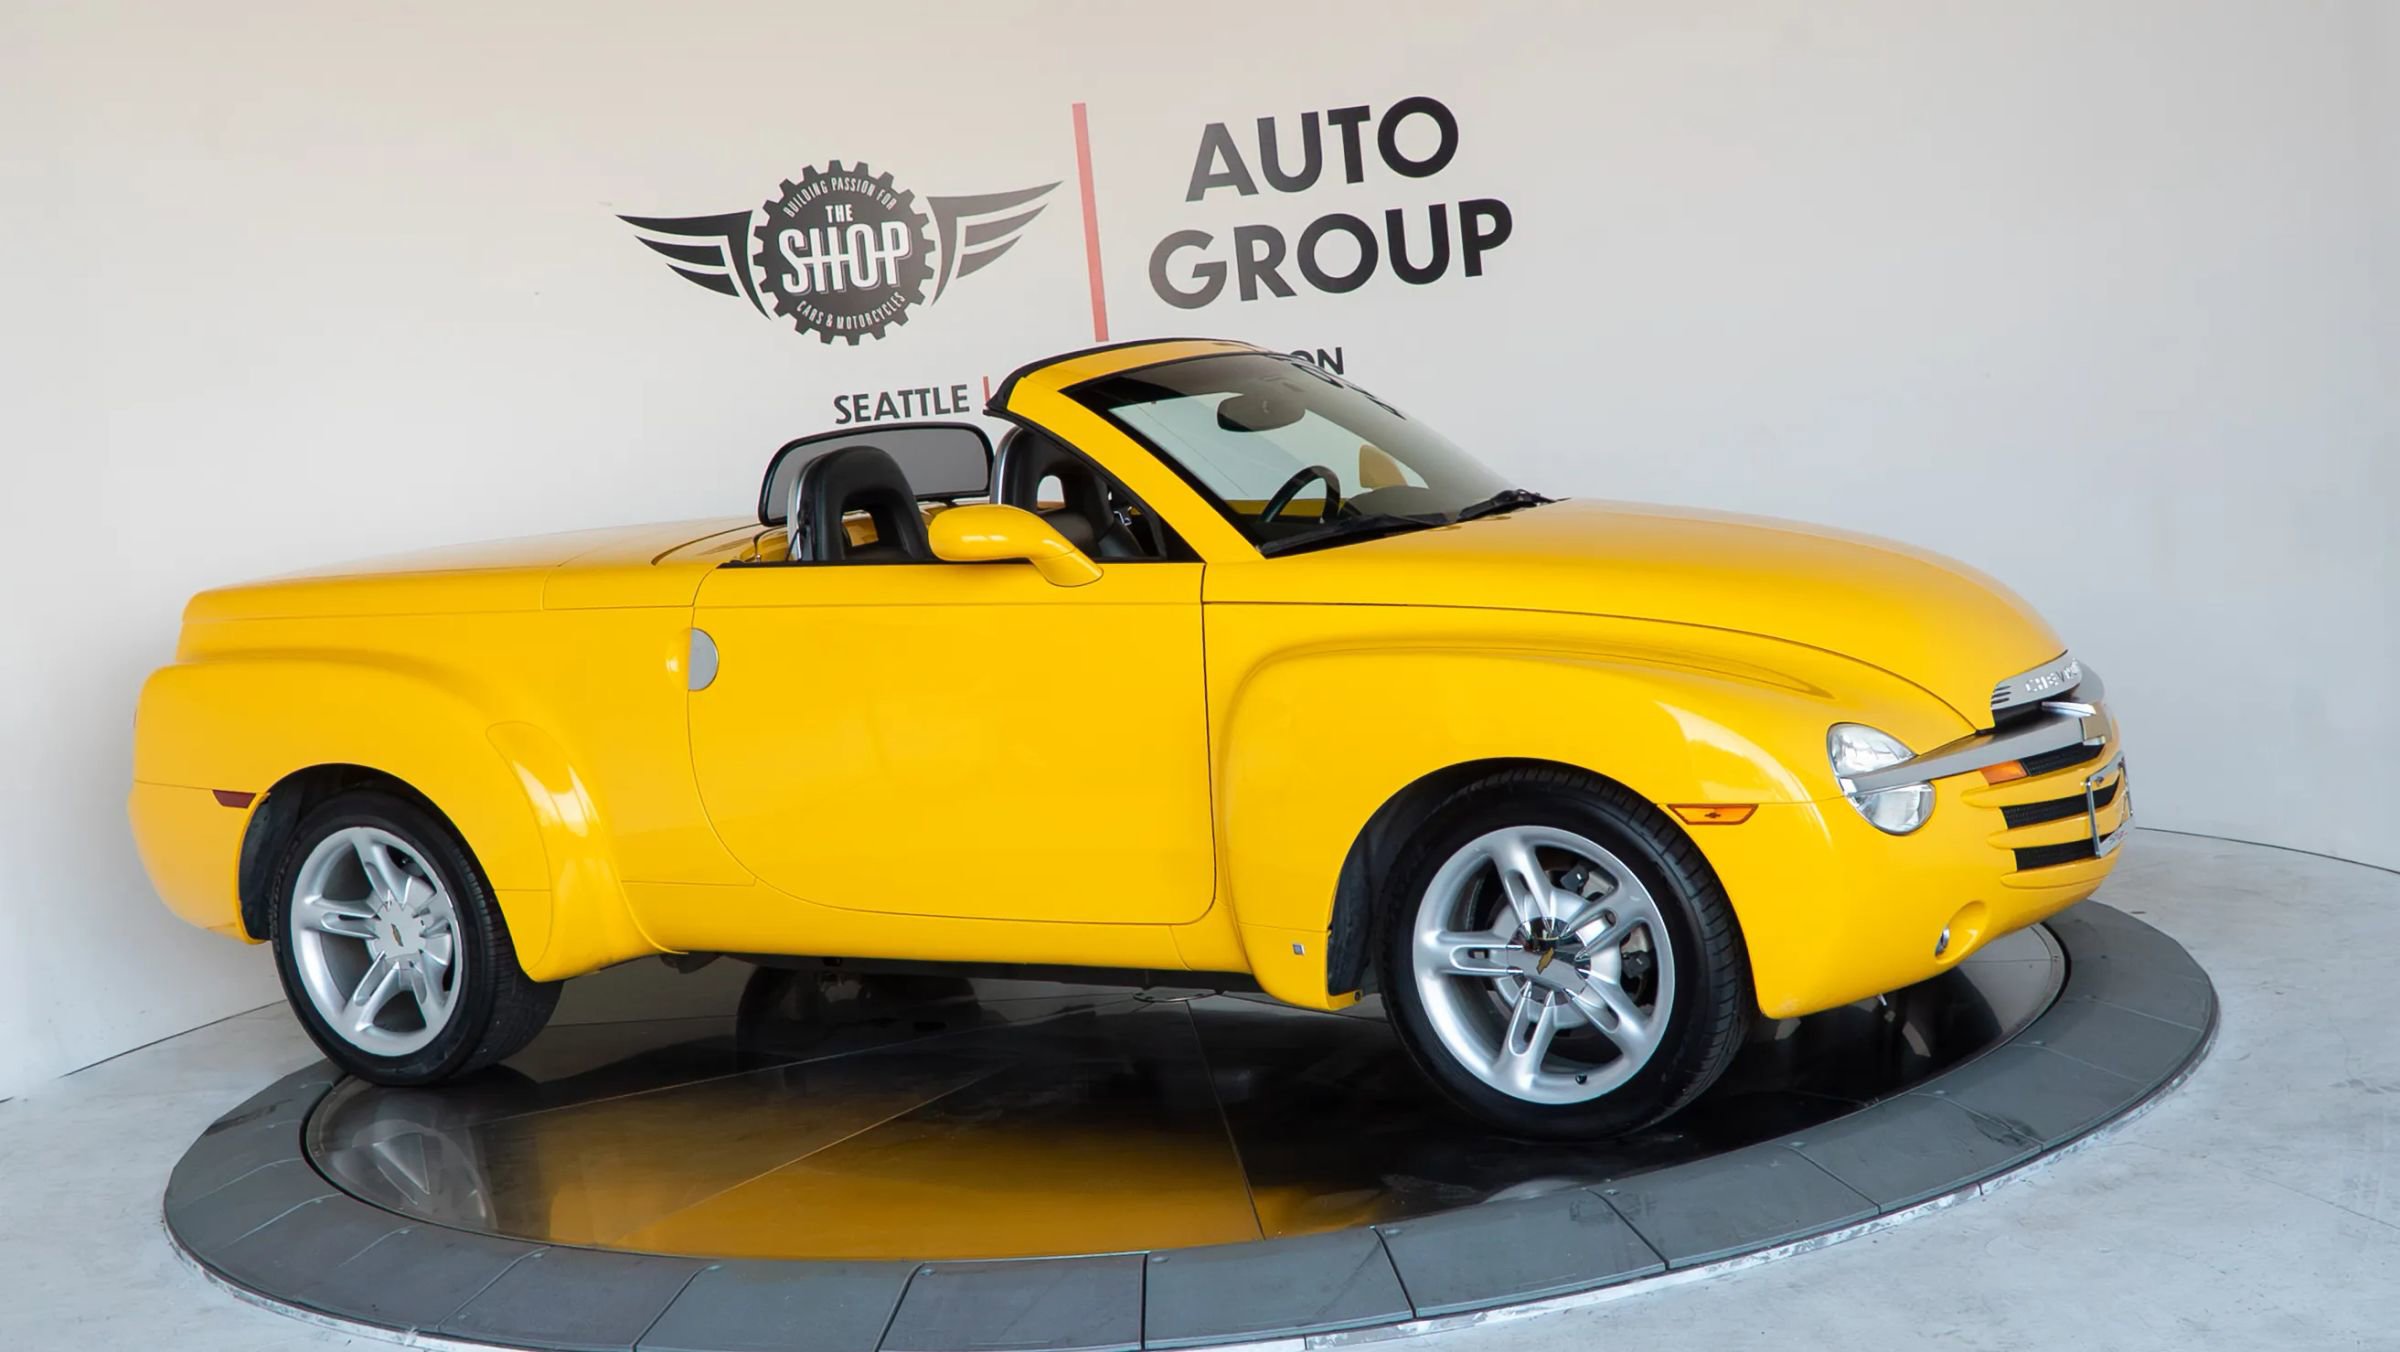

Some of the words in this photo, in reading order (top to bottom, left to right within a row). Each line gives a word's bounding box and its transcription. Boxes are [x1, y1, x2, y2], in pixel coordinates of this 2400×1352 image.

[1186, 96, 1459, 202] AUTO
[783, 180, 828, 218] BUILDING
[831, 177, 876, 197] PASSION
[876, 189, 897, 210] FOR
[825, 204, 853, 223] THE
[778, 221, 912, 296] SHOP
[1149, 198, 1513, 310] GROUP
[797, 301, 825, 325] CARS
[825, 314, 834, 327] &
[836, 291, 906, 330] MOTORCYCLES
[834, 384, 970, 425] SEATTLE
